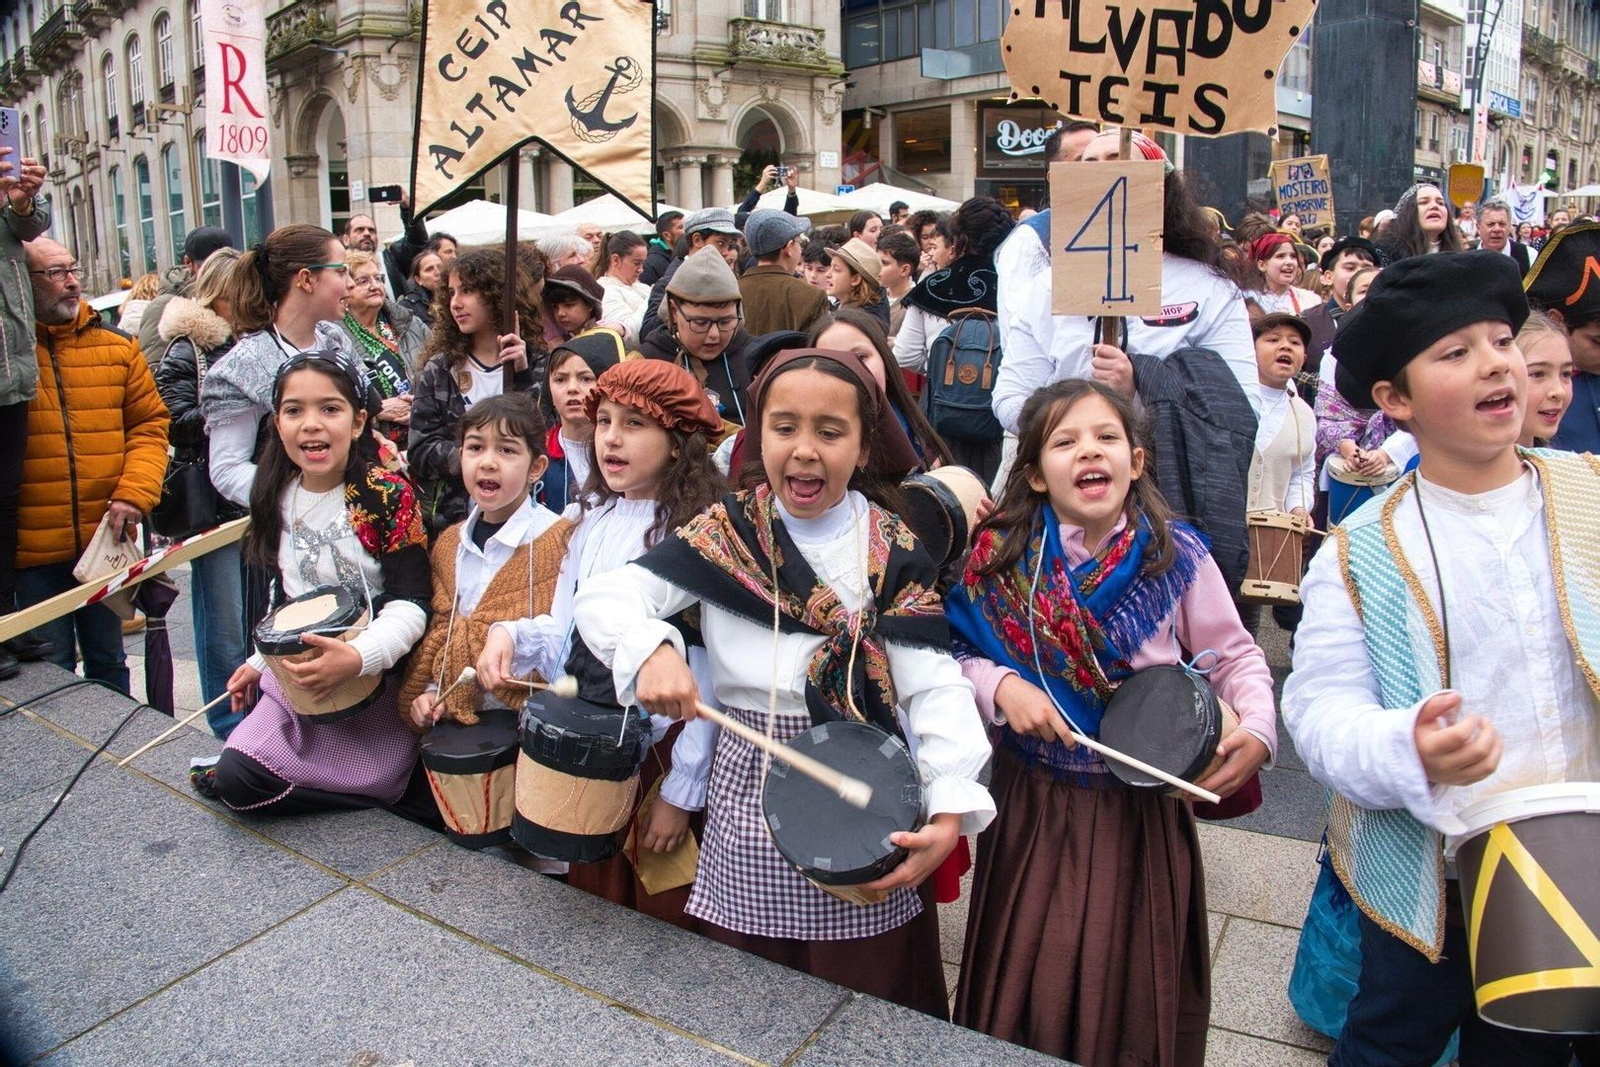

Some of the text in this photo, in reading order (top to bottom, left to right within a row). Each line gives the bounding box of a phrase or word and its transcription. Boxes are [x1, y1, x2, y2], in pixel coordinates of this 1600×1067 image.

[438, 1, 511, 82] CEIP
[1034, 0, 1272, 76] LVADO
[217, 42, 265, 118] R
[428, 1, 605, 180] ALTAMAR
[1059, 70, 1229, 134] TEIS
[219, 124, 268, 154] 1809
[1279, 179, 1329, 200] MOSTEIRO
[1065, 176, 1138, 304] 4
[1161, 306, 1183, 316] HOP
